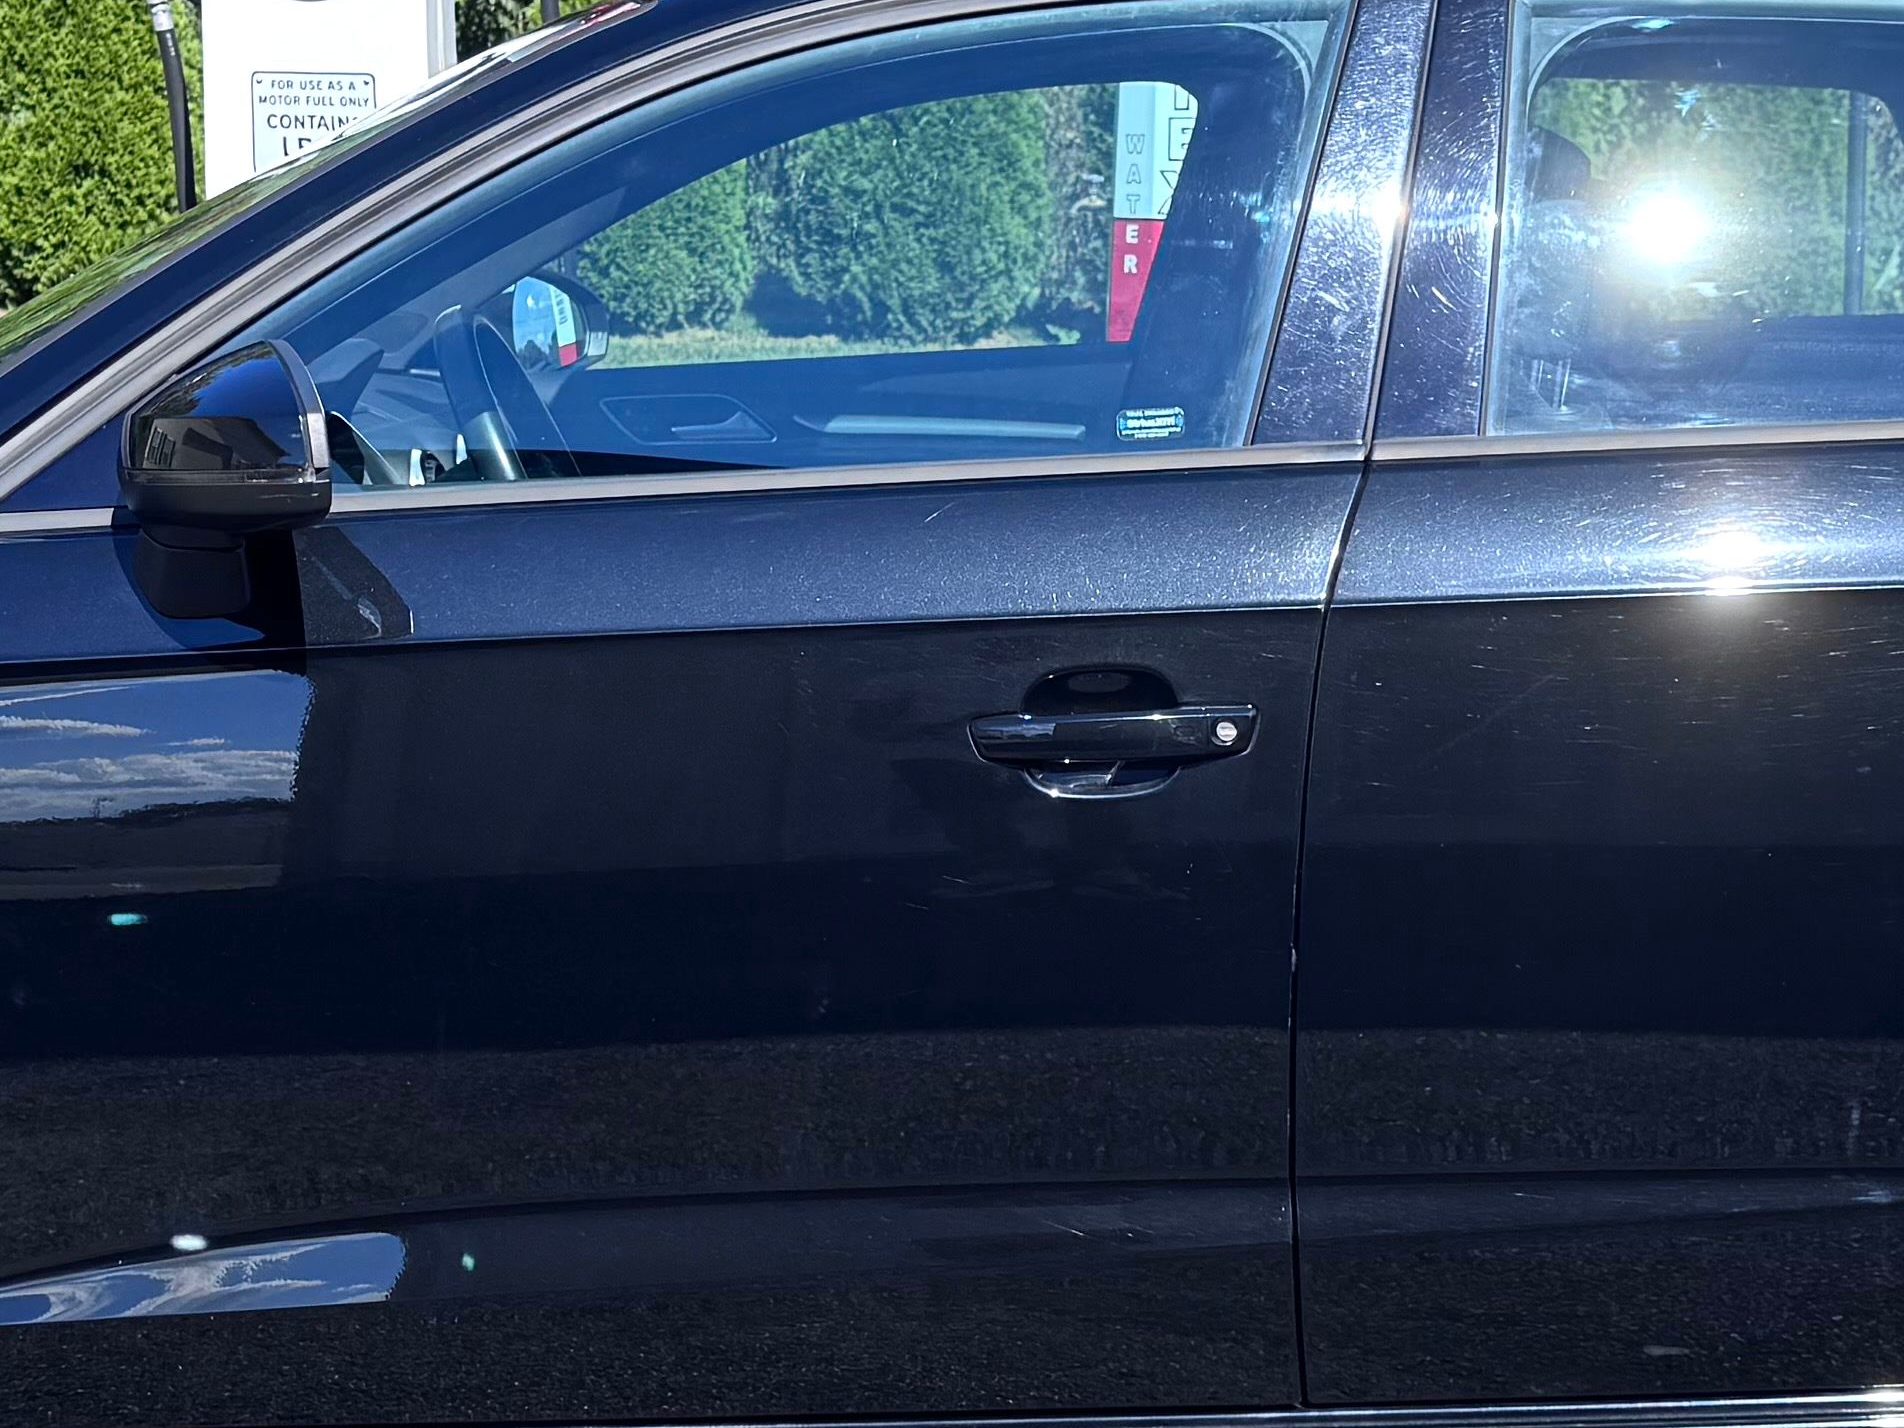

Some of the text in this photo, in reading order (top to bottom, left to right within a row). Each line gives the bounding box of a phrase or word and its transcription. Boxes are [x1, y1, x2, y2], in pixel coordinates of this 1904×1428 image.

[271, 80, 356, 91] FOR USE AS A
[259, 95, 369, 107] MOTOR FUEL ONLY
[267, 113, 358, 131] CONTAIN
[1122, 133, 1146, 275] WATER
